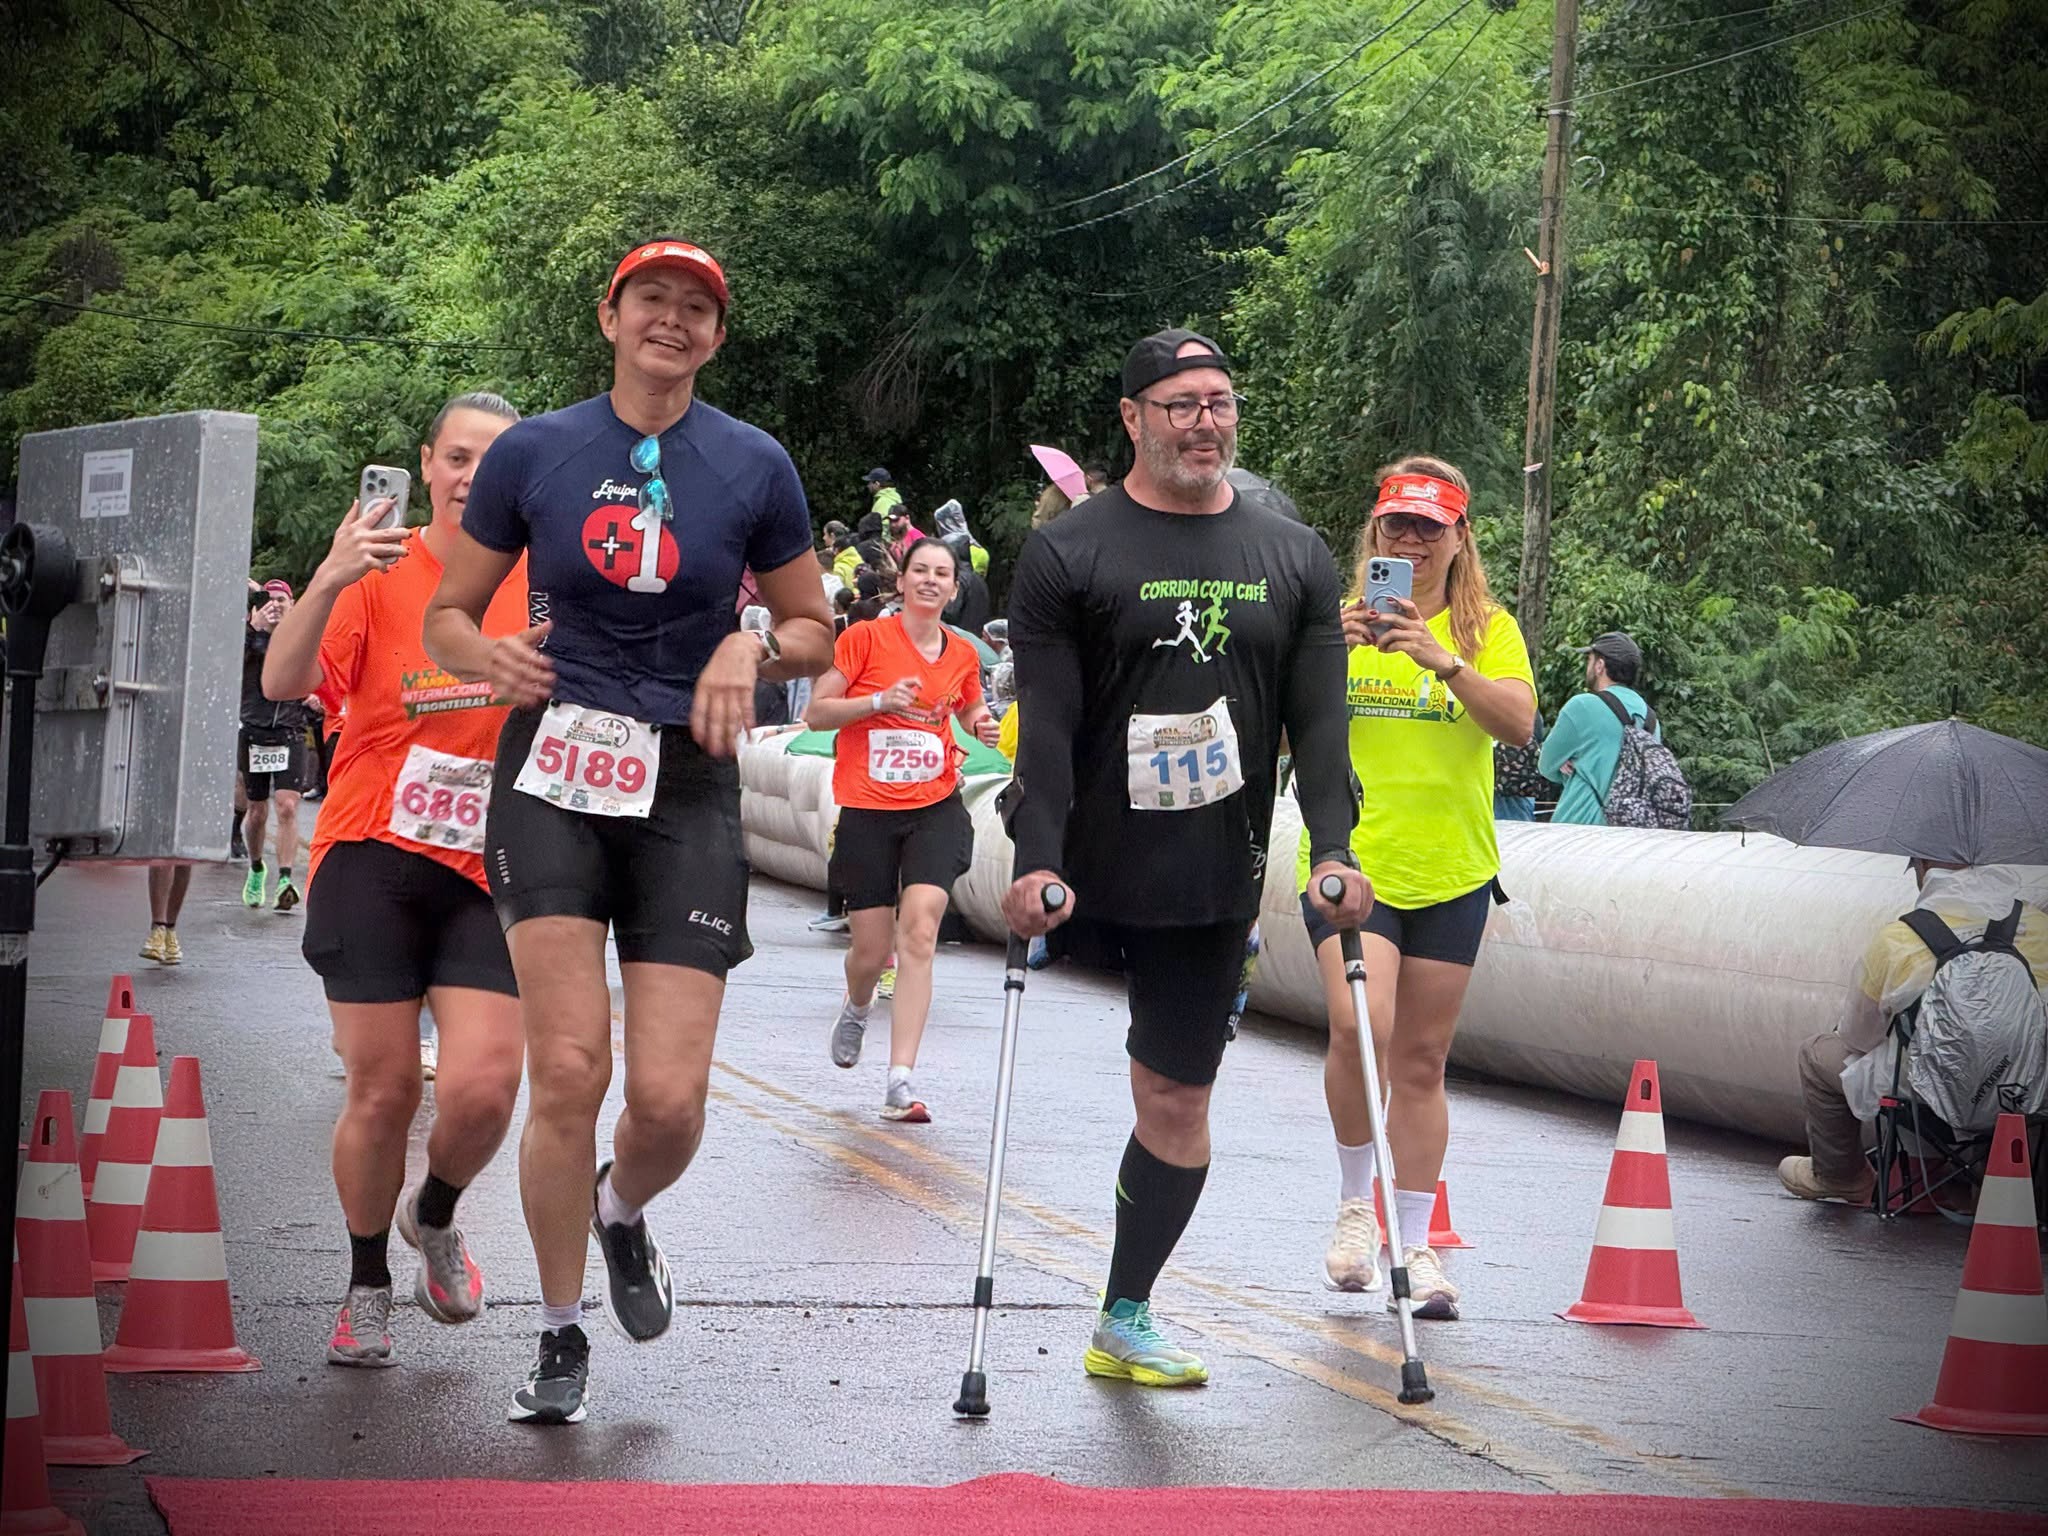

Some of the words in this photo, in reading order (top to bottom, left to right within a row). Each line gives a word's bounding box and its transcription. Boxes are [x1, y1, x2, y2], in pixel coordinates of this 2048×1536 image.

[592, 479, 638, 501] Equipe
[1140, 579, 1198, 601] CORRIDA
[1201, 580, 1234, 598] COM
[1236, 577, 1268, 603] CAFÉ
[416, 696, 488, 714] FRONTEIRAS
[1347, 694, 1417, 708] NTERNACIONAL
[1354, 705, 1412, 718] FRONTEIRAS
[252, 753, 286, 765] 2608
[536, 736, 647, 794] 5189
[873, 749, 939, 769] 7250
[1150, 739, 1228, 785] 115
[688, 909, 734, 936] ELICE
